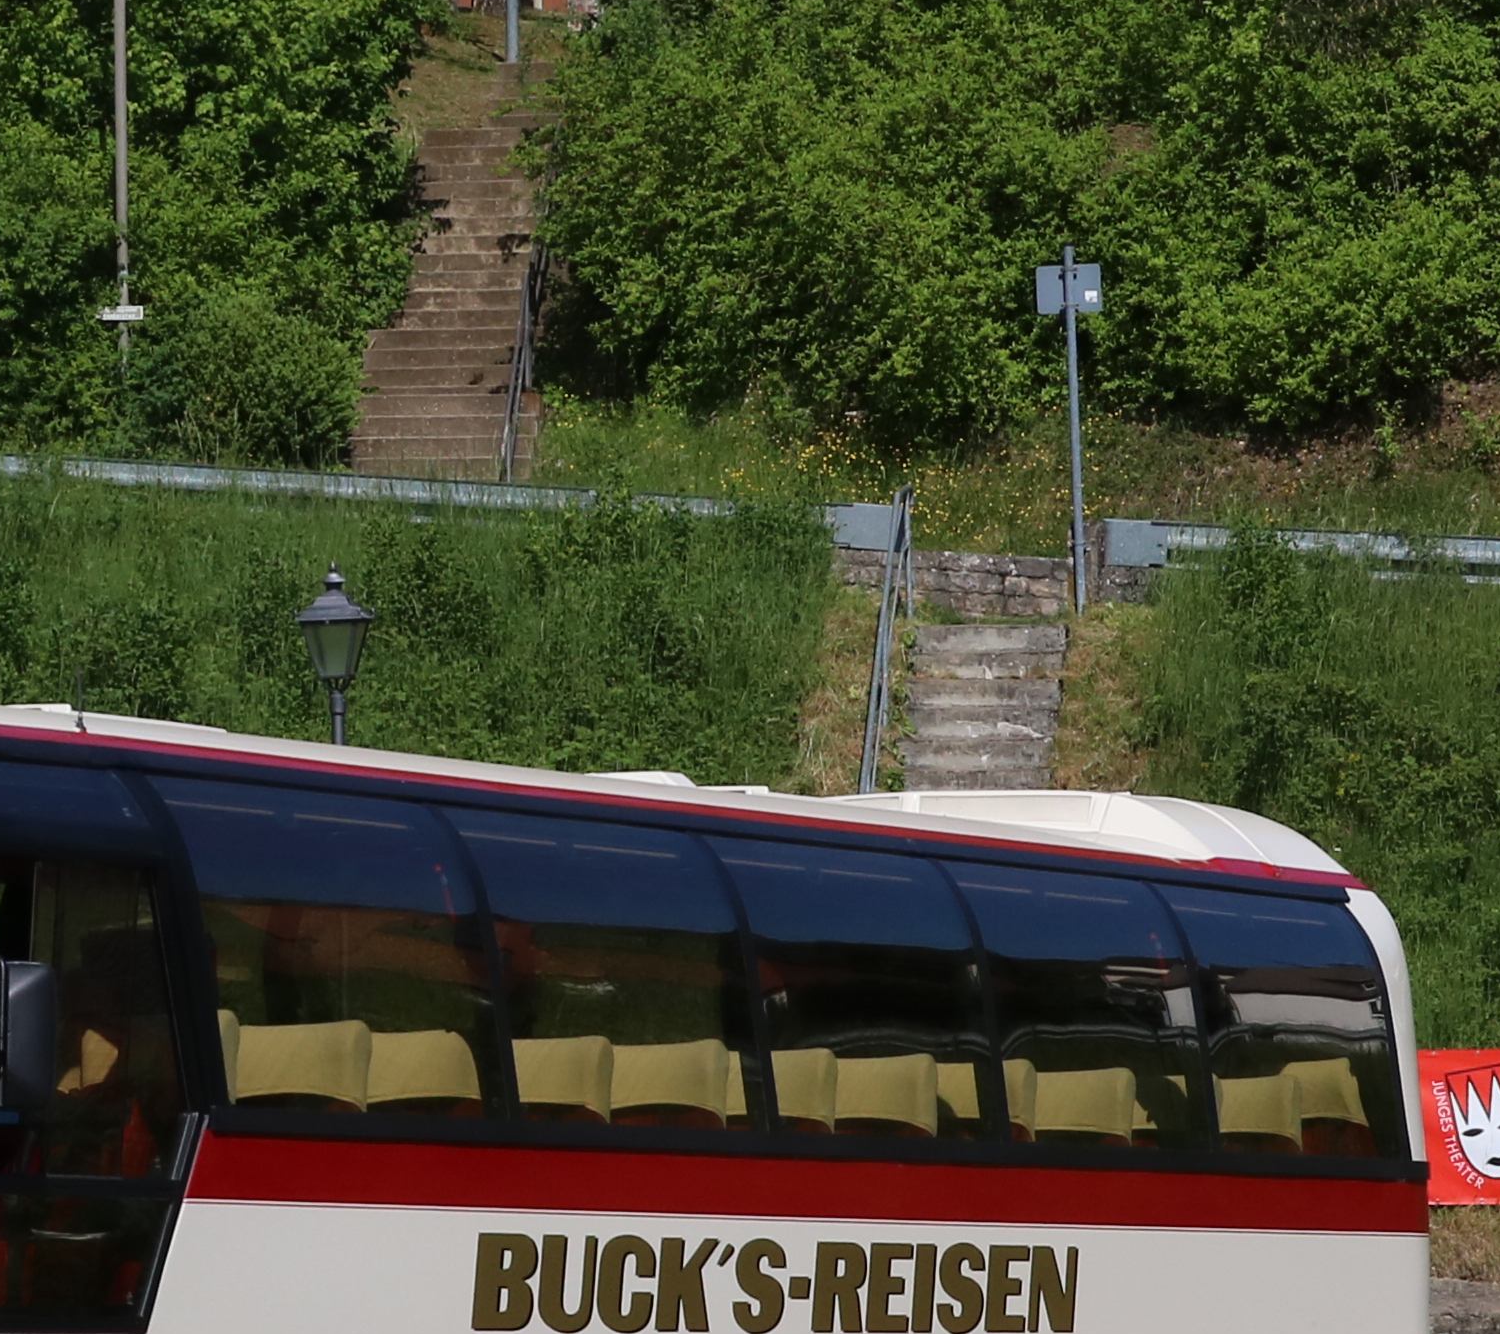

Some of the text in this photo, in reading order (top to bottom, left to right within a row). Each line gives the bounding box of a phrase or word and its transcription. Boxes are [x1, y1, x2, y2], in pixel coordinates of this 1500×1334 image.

[1432, 1080, 1485, 1189] JUNGES THEATER
[471, 1232, 1079, 1334] BUCK'S-REISEN
